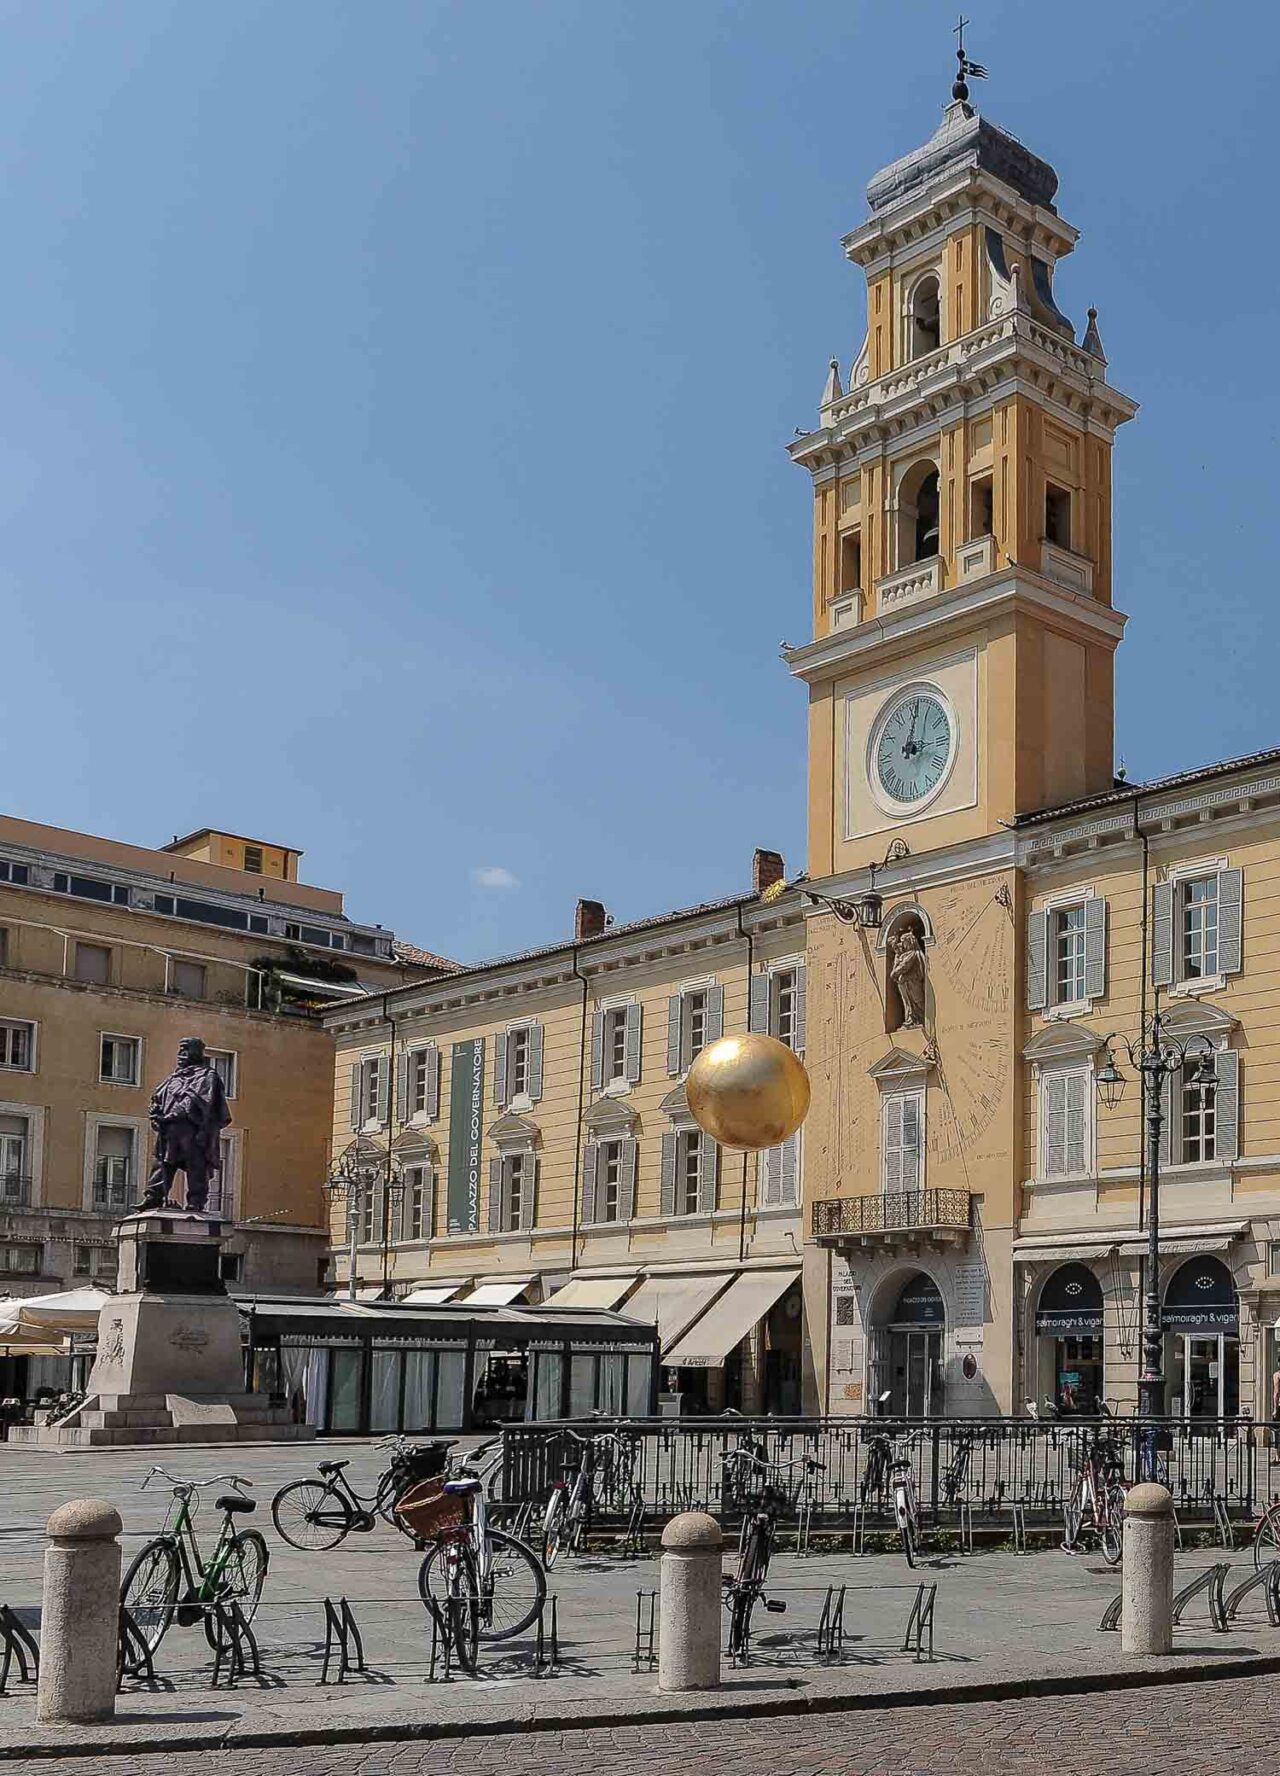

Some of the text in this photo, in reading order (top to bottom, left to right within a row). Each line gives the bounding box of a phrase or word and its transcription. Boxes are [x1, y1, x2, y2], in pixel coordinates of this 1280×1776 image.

[469, 1038, 483, 1231] PALAZZO DEL GOVERNATORE
[1036, 1316, 1077, 1331] salmoiraghi
[1078, 1317, 1083, 1326] &
[1162, 1312, 1208, 1324] salmoiraghi
[1209, 1313, 1215, 1322] &
